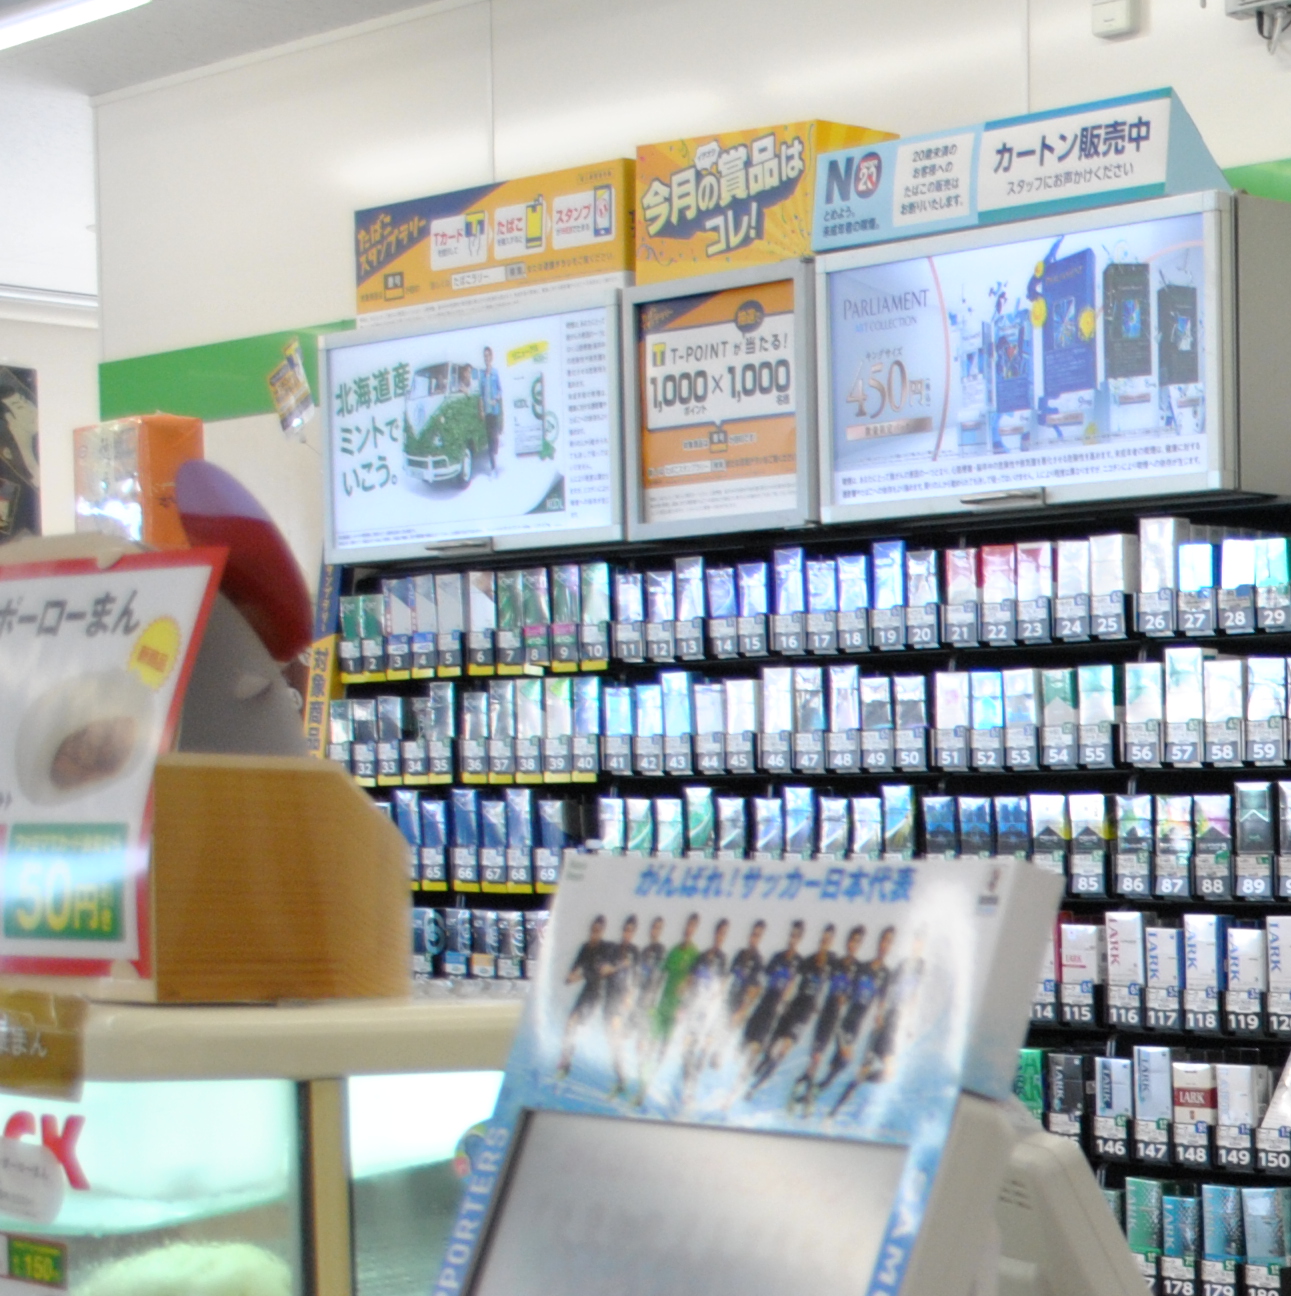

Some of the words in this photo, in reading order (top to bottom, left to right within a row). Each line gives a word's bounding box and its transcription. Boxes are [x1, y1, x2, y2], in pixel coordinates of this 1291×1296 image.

[993, 115, 1151, 174] カートン販売中
[912, 161, 954, 179] お客様への
[641, 134, 805, 238] 今月の賞品は
[1006, 162, 1134, 197] スタッフにお声かけください
[904, 178, 959, 198] たばこの販売は
[555, 203, 592, 225] スタンプ
[497, 217, 523, 235] たばこ
[704, 201, 759, 259] コレ!
[842, 288, 930, 322] PARLIAMENT
[670, 341, 728, 366] T-POINT
[335, 362, 411, 418] 北海道産
[340, 416, 400, 456] ミントで
[342, 455, 398, 497] いこう。
[1146, 615, 1165, 630] 26
[1226, 611, 1245, 626] 28
[913, 628, 930, 642] 20
[1062, 620, 1081, 635] 24
[780, 635, 797, 648] 16
[652, 643, 667, 656] 12
[977, 751, 995, 764] 52
[1132, 746, 1151, 760] 56
[1212, 745, 1233, 759] 58
[408, 760, 422, 772] 34
[834, 753, 852, 767] 48
[458, 867, 473, 879] 66
[511, 868, 526, 880] 68
[634, 867, 918, 903] がんばれ!サッカー日本代表
[1123, 878, 1144, 893] 86
[1202, 878, 1223, 893] 88
[1064, 1006, 1092, 1020] 115
[1149, 1011, 1177, 1026] 117
[1187, 1013, 1216, 1027] 118
[1179, 1092, 1205, 1104] LARK
[1097, 1139, 1125, 1154] 146
[1177, 1148, 1207, 1162] 148
[1219, 1151, 1250, 1164] 149
[1260, 1152, 1290, 1167] 150
[1164, 1280, 1194, 1295] 178
